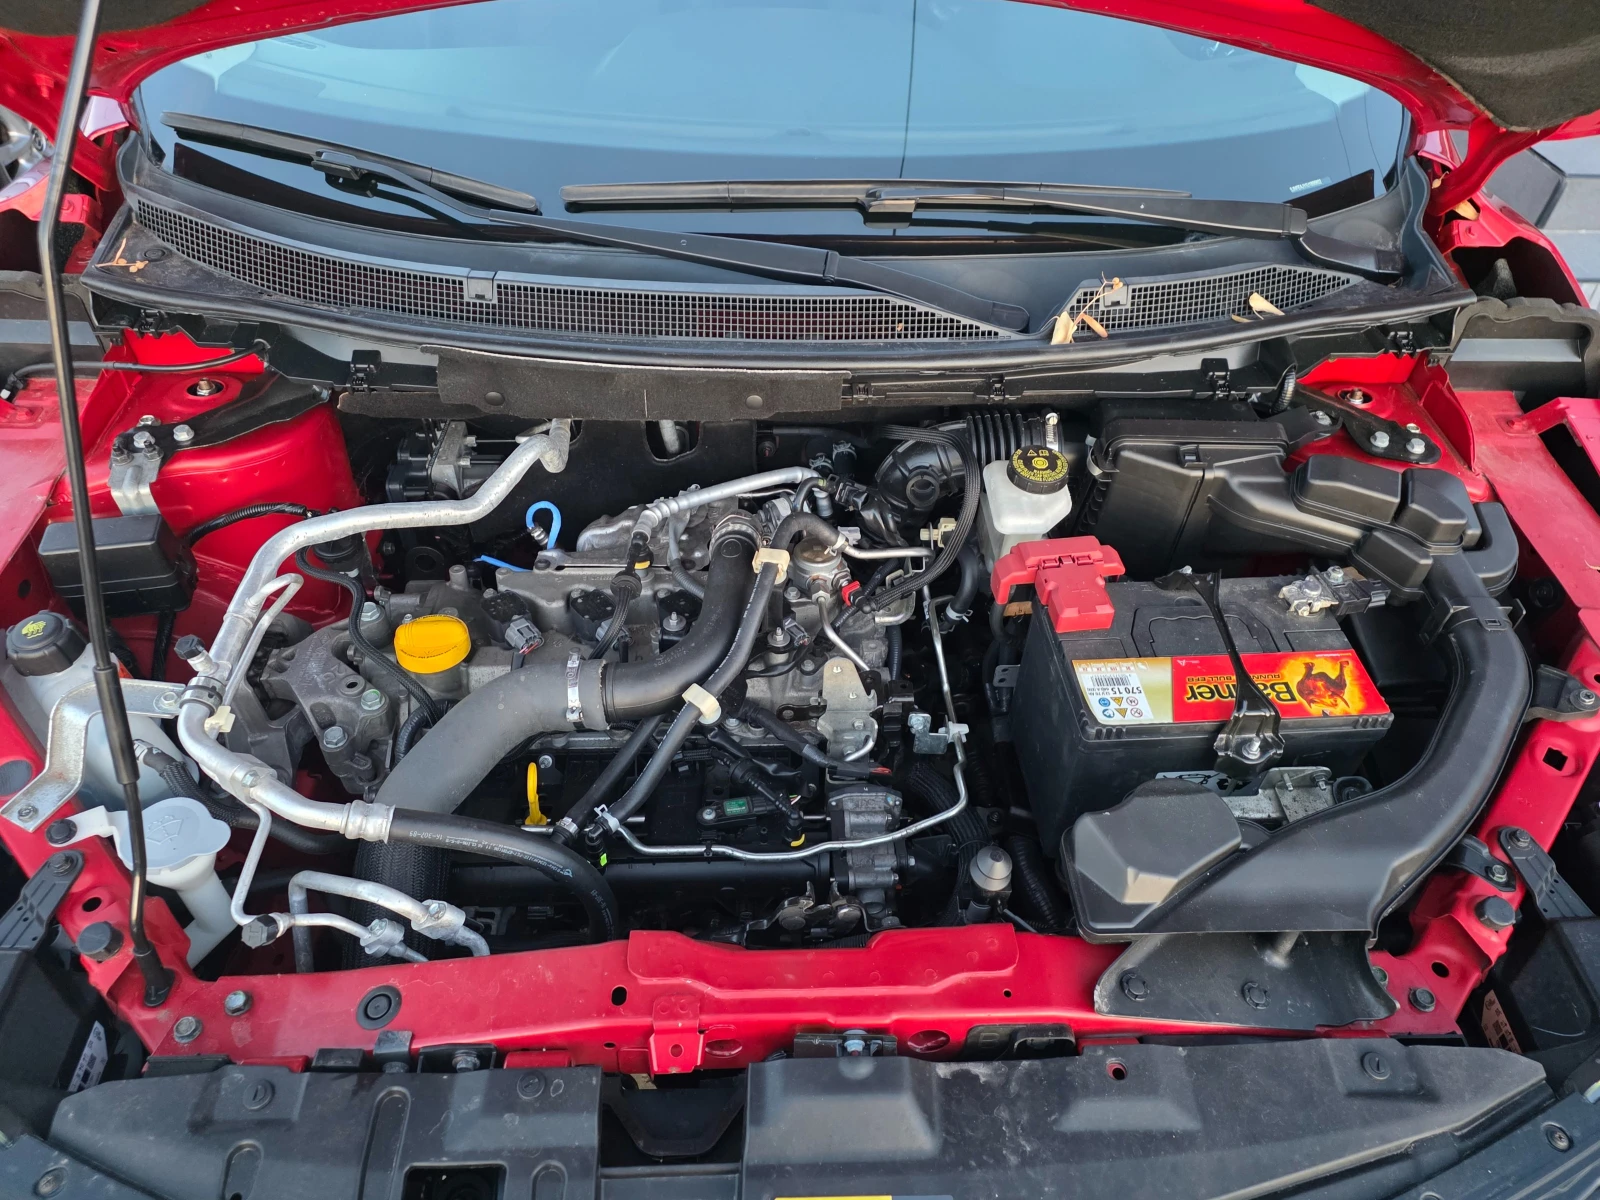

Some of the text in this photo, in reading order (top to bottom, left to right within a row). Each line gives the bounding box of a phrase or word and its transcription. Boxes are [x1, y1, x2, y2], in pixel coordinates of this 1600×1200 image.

[1111, 686, 1142, 694] 570 15
[1186, 681, 1298, 702] Baner
